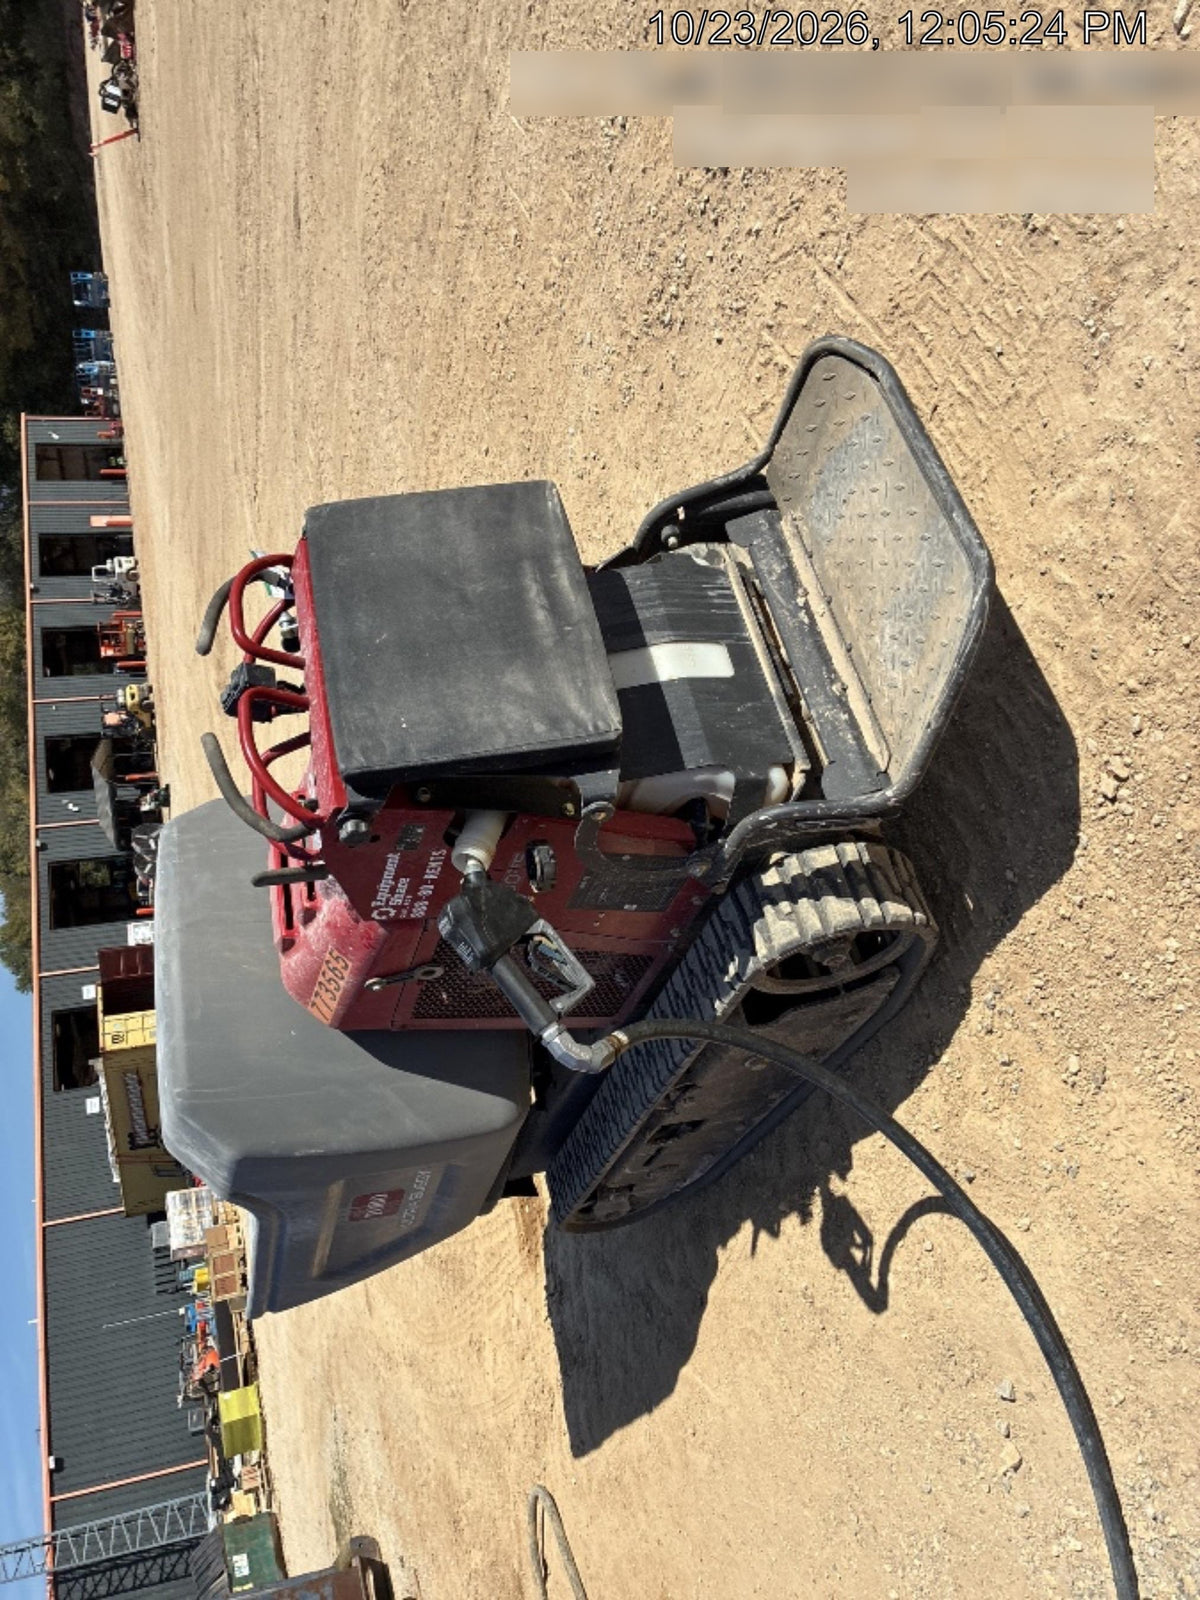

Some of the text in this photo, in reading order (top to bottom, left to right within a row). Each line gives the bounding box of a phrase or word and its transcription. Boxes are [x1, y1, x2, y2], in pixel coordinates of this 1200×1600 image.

[371, 852, 400, 907] Equipment
[389, 878, 410, 906] Share
[311, 948, 349, 1022] 773565
